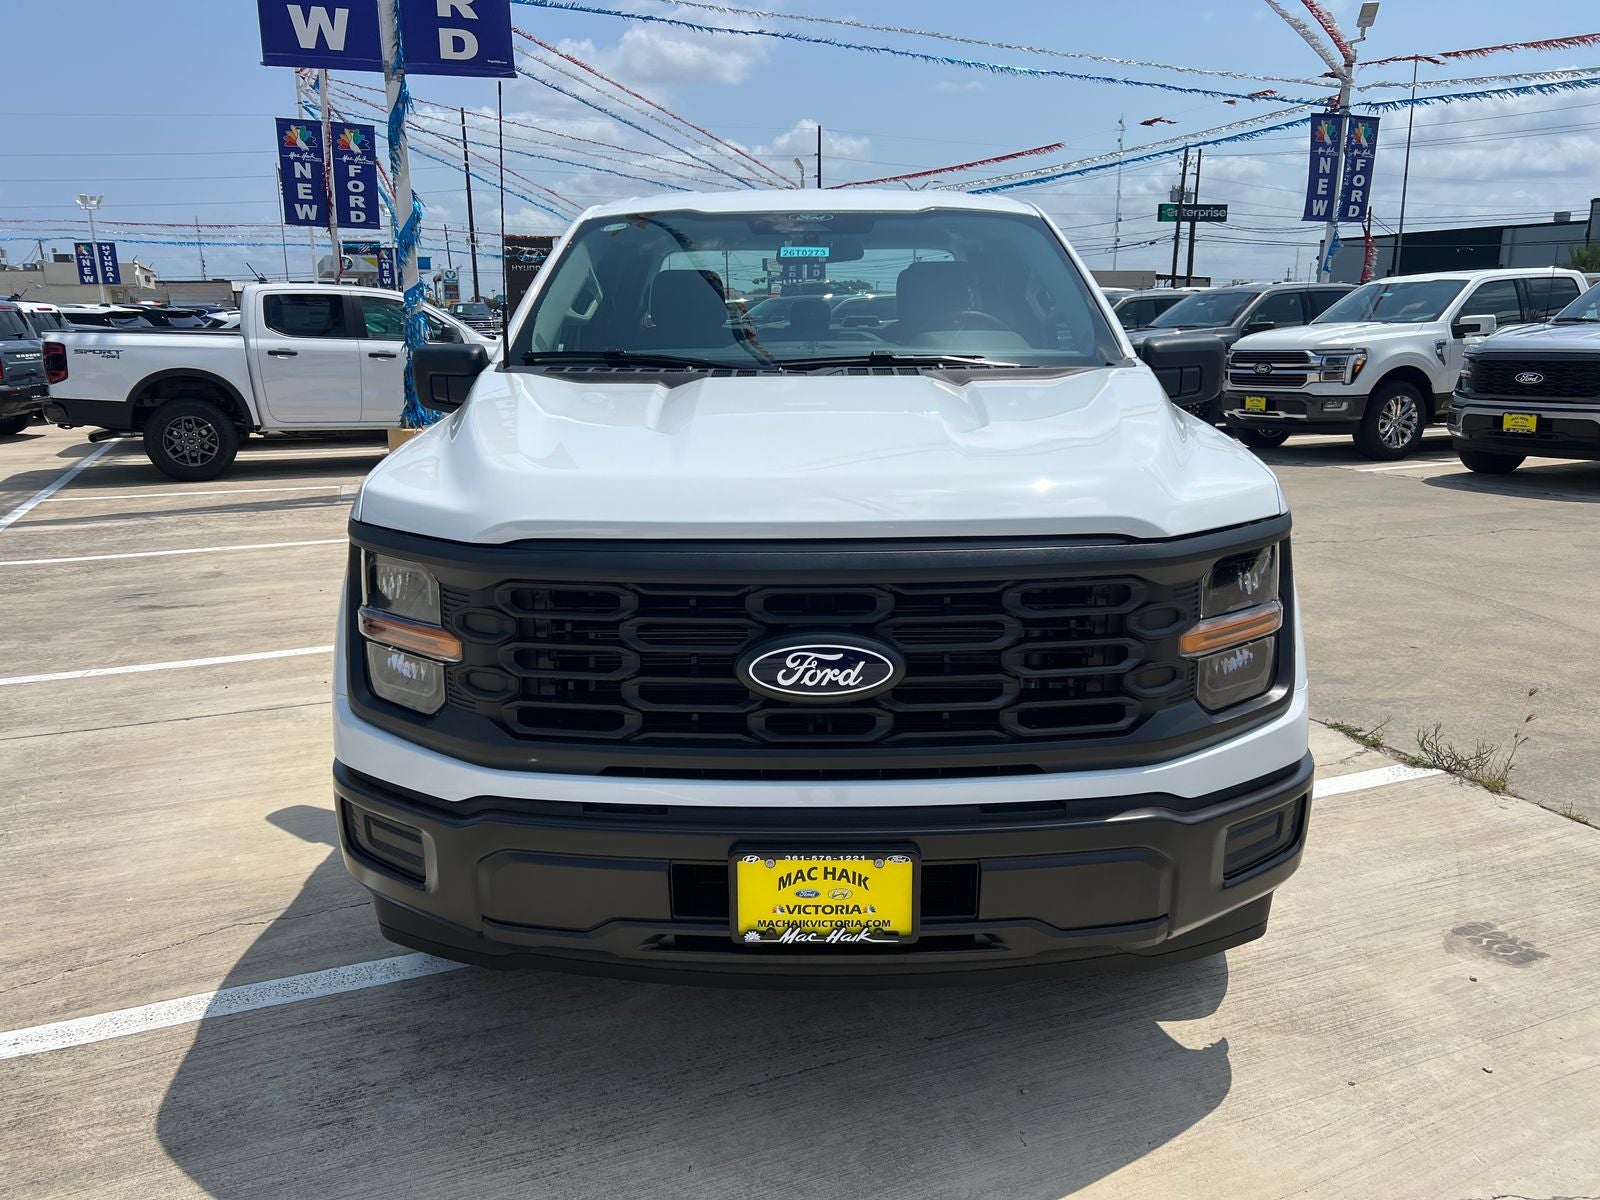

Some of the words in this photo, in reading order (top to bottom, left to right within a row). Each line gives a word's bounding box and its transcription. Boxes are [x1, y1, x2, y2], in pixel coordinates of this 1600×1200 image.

[293, 161, 318, 221] NEW
[346, 164, 367, 223] FORD
[1312, 157, 1331, 216] NEW
[1347, 158, 1367, 218] FORD
[101, 245, 115, 282] HYUNDAI
[783, 249, 826, 257] 26T0273
[81, 259, 94, 283] NEW
[382, 262, 392, 285] NEW
[776, 651, 866, 687] Ford
[778, 866, 818, 892] MAC
[823, 866, 870, 892] HAIK
[785, 904, 863, 915] VICTORIA
[757, 919, 891, 928] MACHAIKVICTORIA.COM
[779, 927, 822, 944] Mac
[824, 927, 871, 944] Haik
